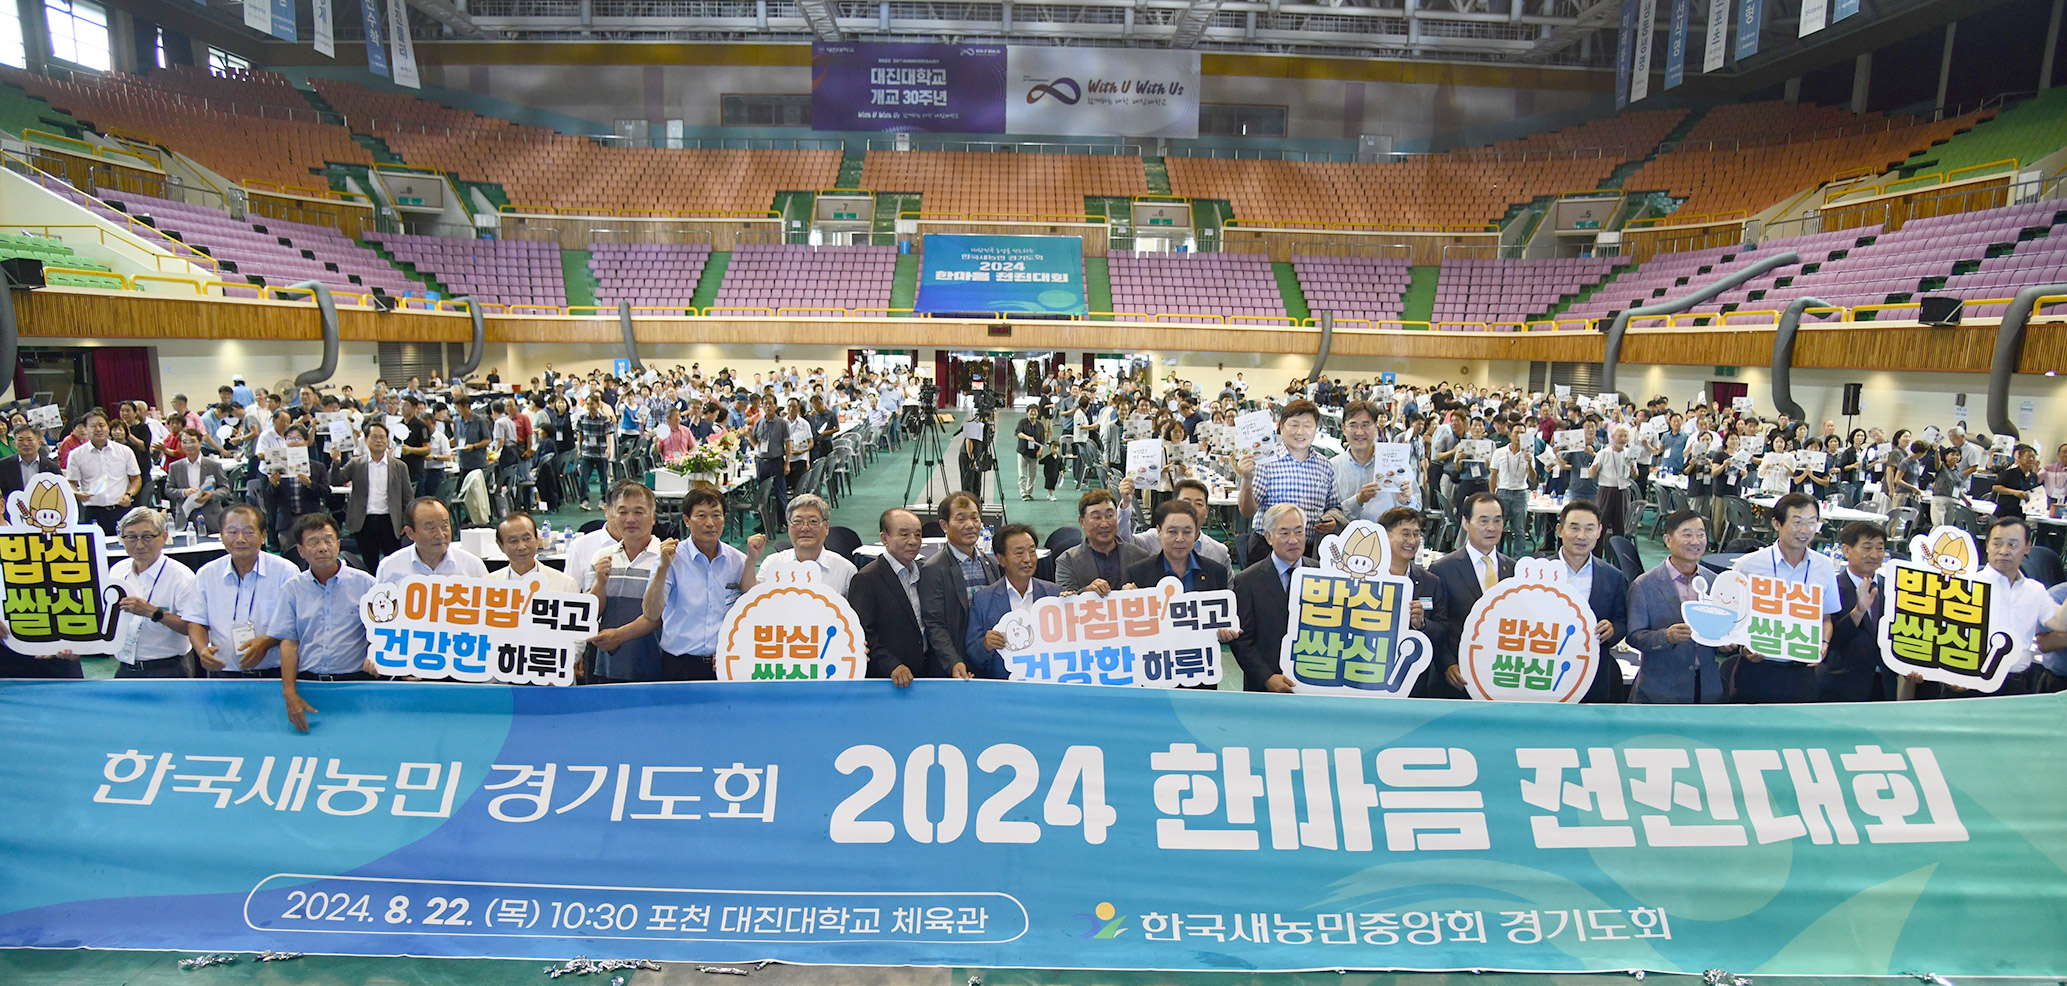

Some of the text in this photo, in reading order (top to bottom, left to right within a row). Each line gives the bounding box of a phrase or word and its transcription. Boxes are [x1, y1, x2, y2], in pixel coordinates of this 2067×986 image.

[871, 68, 947, 86] 대진대학교
[1087, 78, 1184, 96] With U With Us
[871, 89, 948, 106] 개교 30주년
[406, 186, 413, 195] 8
[842, 203, 849, 211] 7
[1158, 209, 1164, 217] 6
[1585, 210, 1592, 219] 5
[935, 270, 1069, 283] 한마음 전진대회
[979, 261, 1026, 271] 2024
[0, 535, 91, 584] 밥심
[4, 587, 99, 636] 쌀심
[404, 582, 591, 632] 아침밥 먹고
[1300, 577, 1396, 632] 밥심
[1750, 575, 1821, 621] 밥심
[1896, 569, 1984, 624] 밥심
[1039, 595, 1232, 642] 아침밥 먹고
[1498, 617, 1560, 654] 밥심
[374, 627, 568, 678] 건강한 하루!
[754, 625, 819, 659] 밥심
[1292, 629, 1389, 684] 쌀심
[1748, 616, 1819, 661] 쌀심
[1890, 613, 1981, 671] 쌀심
[1142, 646, 1215, 681] 하루!
[1491, 654, 1555, 691] 쌀심
[93, 742, 1970, 852] 한국새농민 경기도회 2024 한마음 전진대회
[281, 890, 988, 934] 2024. 8. 22. (목) 10:30 포천 대진대학교 체육관
[1141, 906, 1673, 945] 한국새농민중앙회 경기도회
